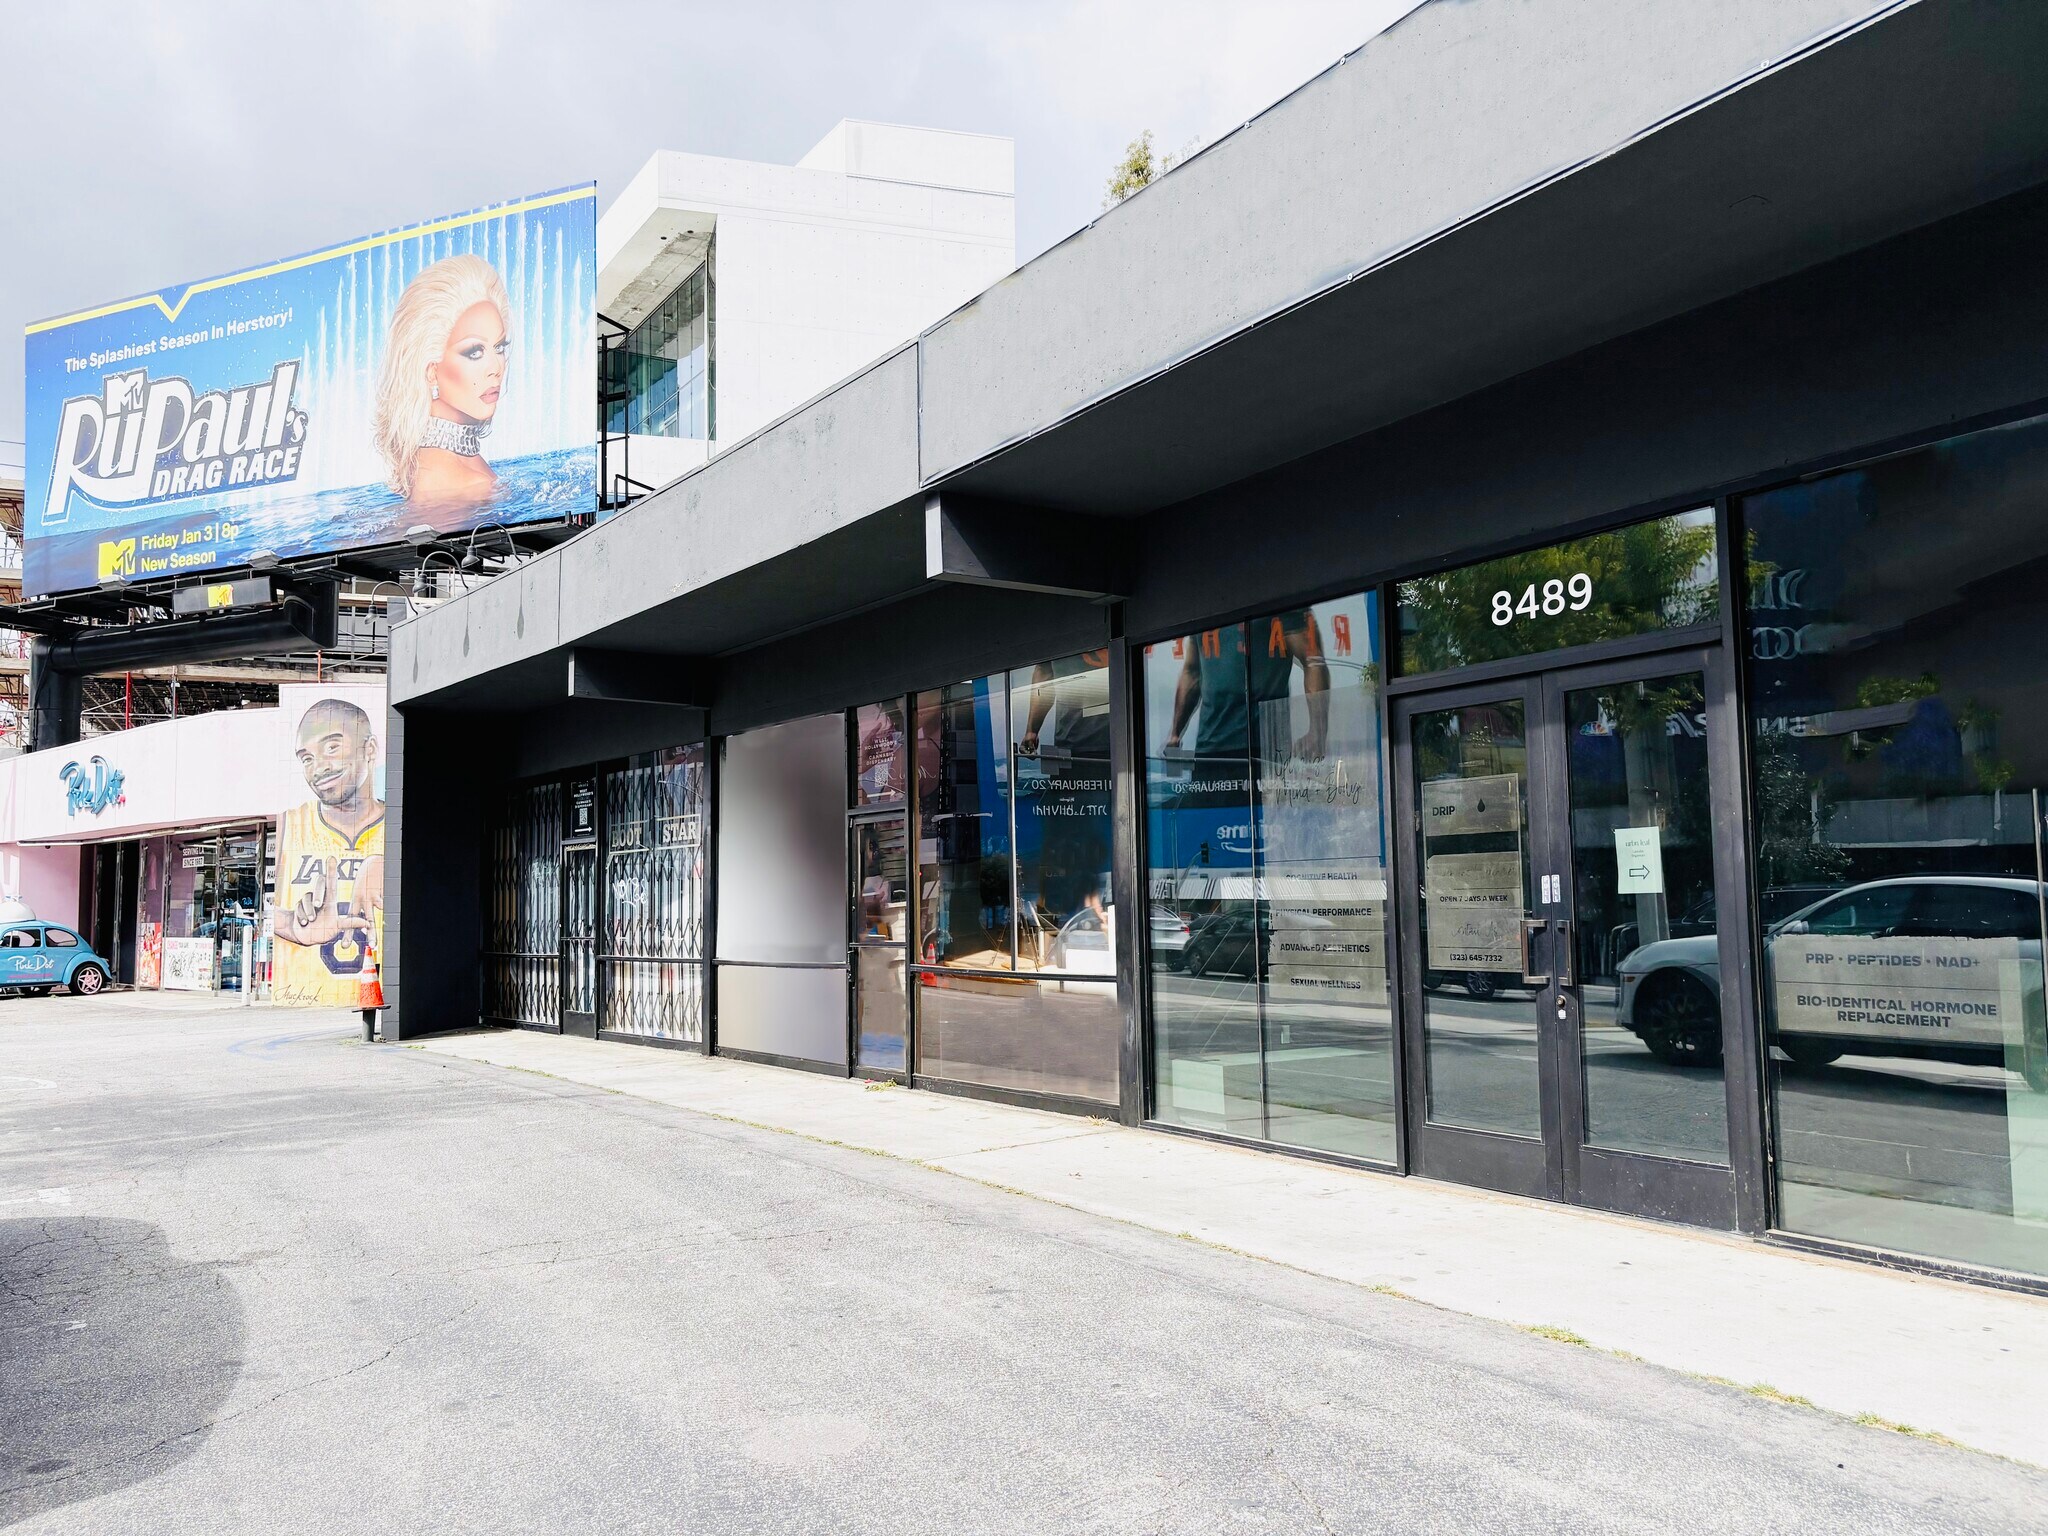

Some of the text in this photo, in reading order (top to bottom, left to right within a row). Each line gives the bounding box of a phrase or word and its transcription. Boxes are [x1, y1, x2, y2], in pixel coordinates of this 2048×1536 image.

[65, 307, 293, 373] The Splashiest Season In Herstory!
[106, 372, 144, 416] MTV
[153, 448, 299, 497] DRAG RACE
[141, 532, 179, 551] Friday
[181, 528, 201, 545] Jan
[204, 525, 212, 540] 3
[222, 522, 239, 542] 8p
[98, 537, 136, 579] MTV
[141, 550, 216, 573] New Season
[208, 584, 234, 608] MTV
[1491, 572, 1592, 626] 8489
[1432, 806, 1456, 817] DRIP
[611, 822, 697, 848] BOOT STAR
[1327, 872, 1358, 881] HEALTH
[1439, 895, 1458, 903] OPEN
[1488, 894, 1508, 902] WEEK
[1312, 907, 1372, 917] PERFORMANCE
[1280, 943, 1370, 953] ADVANCED AESTHETICS
[1450, 953, 1503, 962] (323) 645-7332
[1805, 953, 1980, 968] PRP PEPTIDES NAD+
[1290, 978, 1361, 989] SEXUAL WELLNESS
[1797, 995, 1997, 1016] BIO-IDENTICAL HORMONE
[1837, 1010, 1952, 1028] REPLACEMENT
